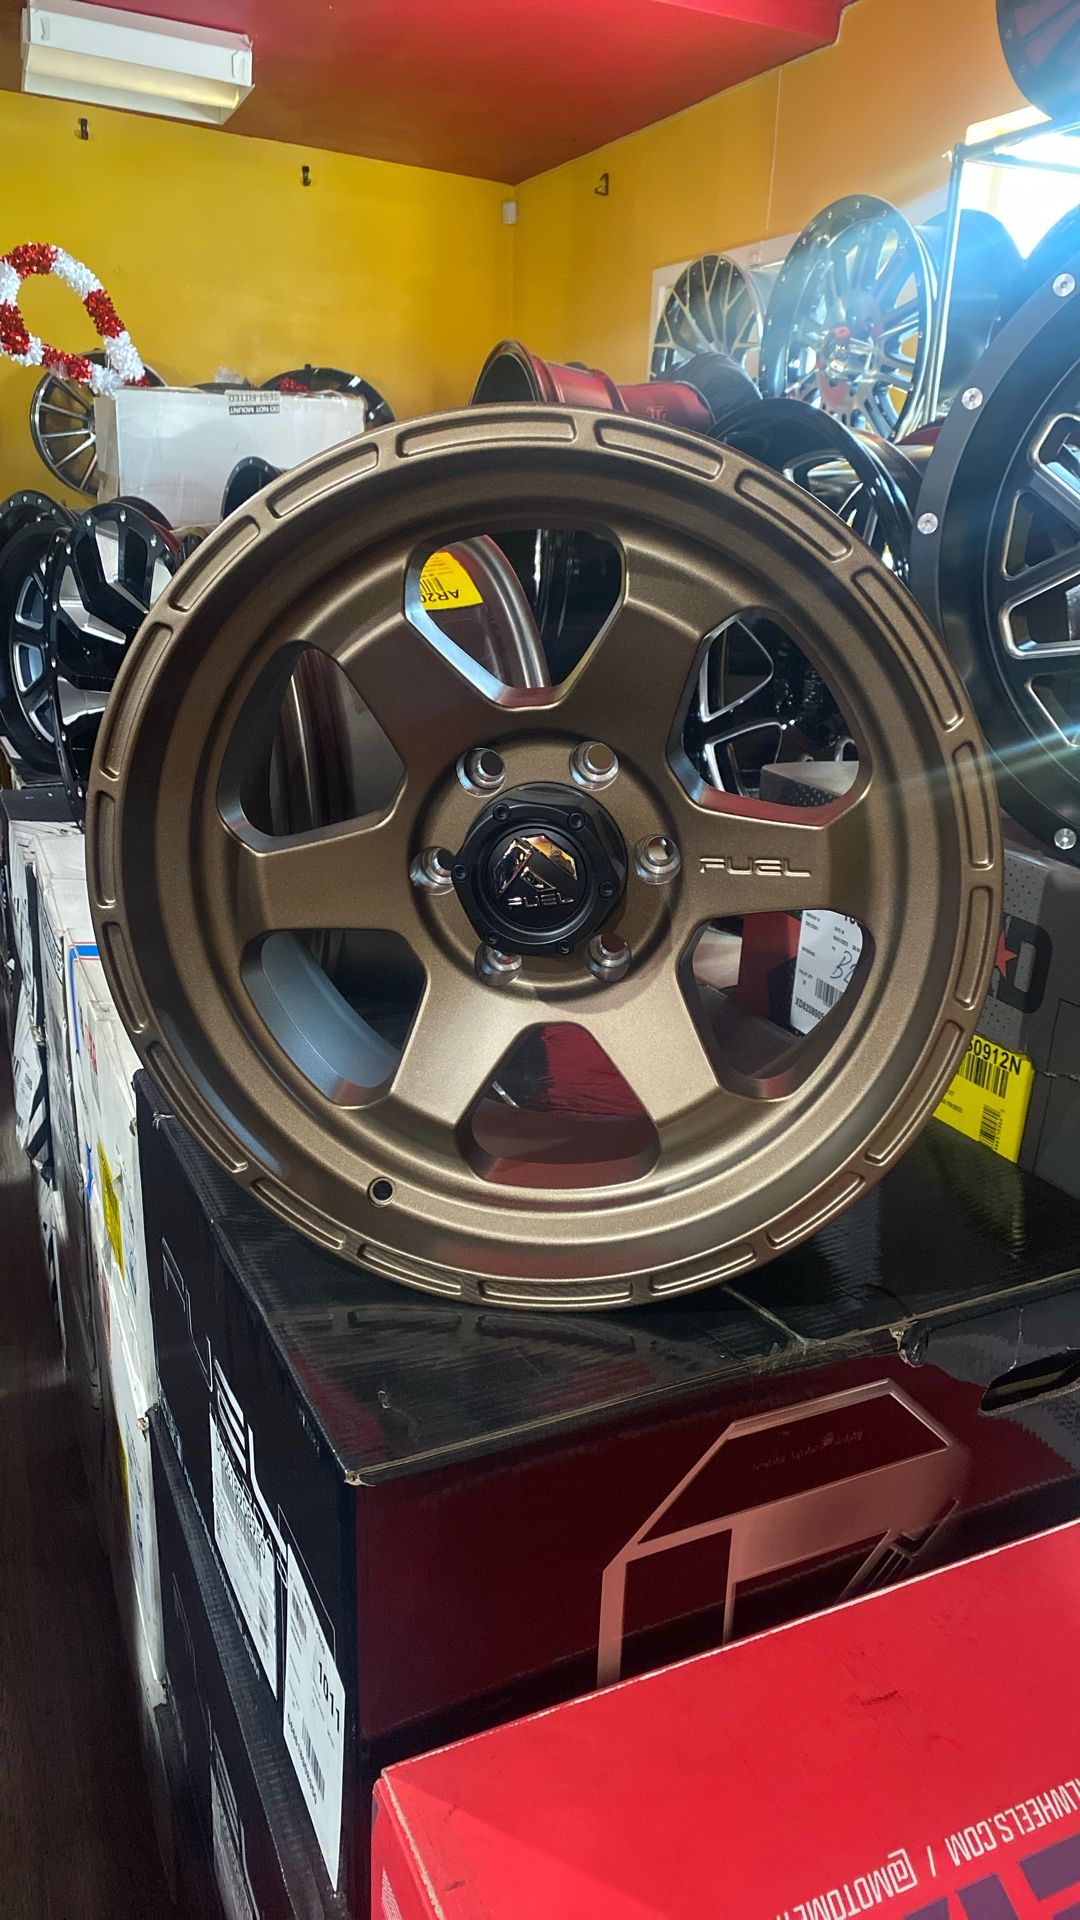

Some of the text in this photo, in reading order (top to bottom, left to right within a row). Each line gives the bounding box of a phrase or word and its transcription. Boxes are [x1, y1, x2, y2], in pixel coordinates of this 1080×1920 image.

[230, 405, 280, 414] DO NOT MOUNT
[699, 857, 811, 877] FUEL
[507, 892, 574, 912] FUEL
[317, 1661, 340, 1733] 1011
[944, 1777, 1080, 1867] LWHEELS.COM
[774, 1847, 919, 1920] @MOTOME
